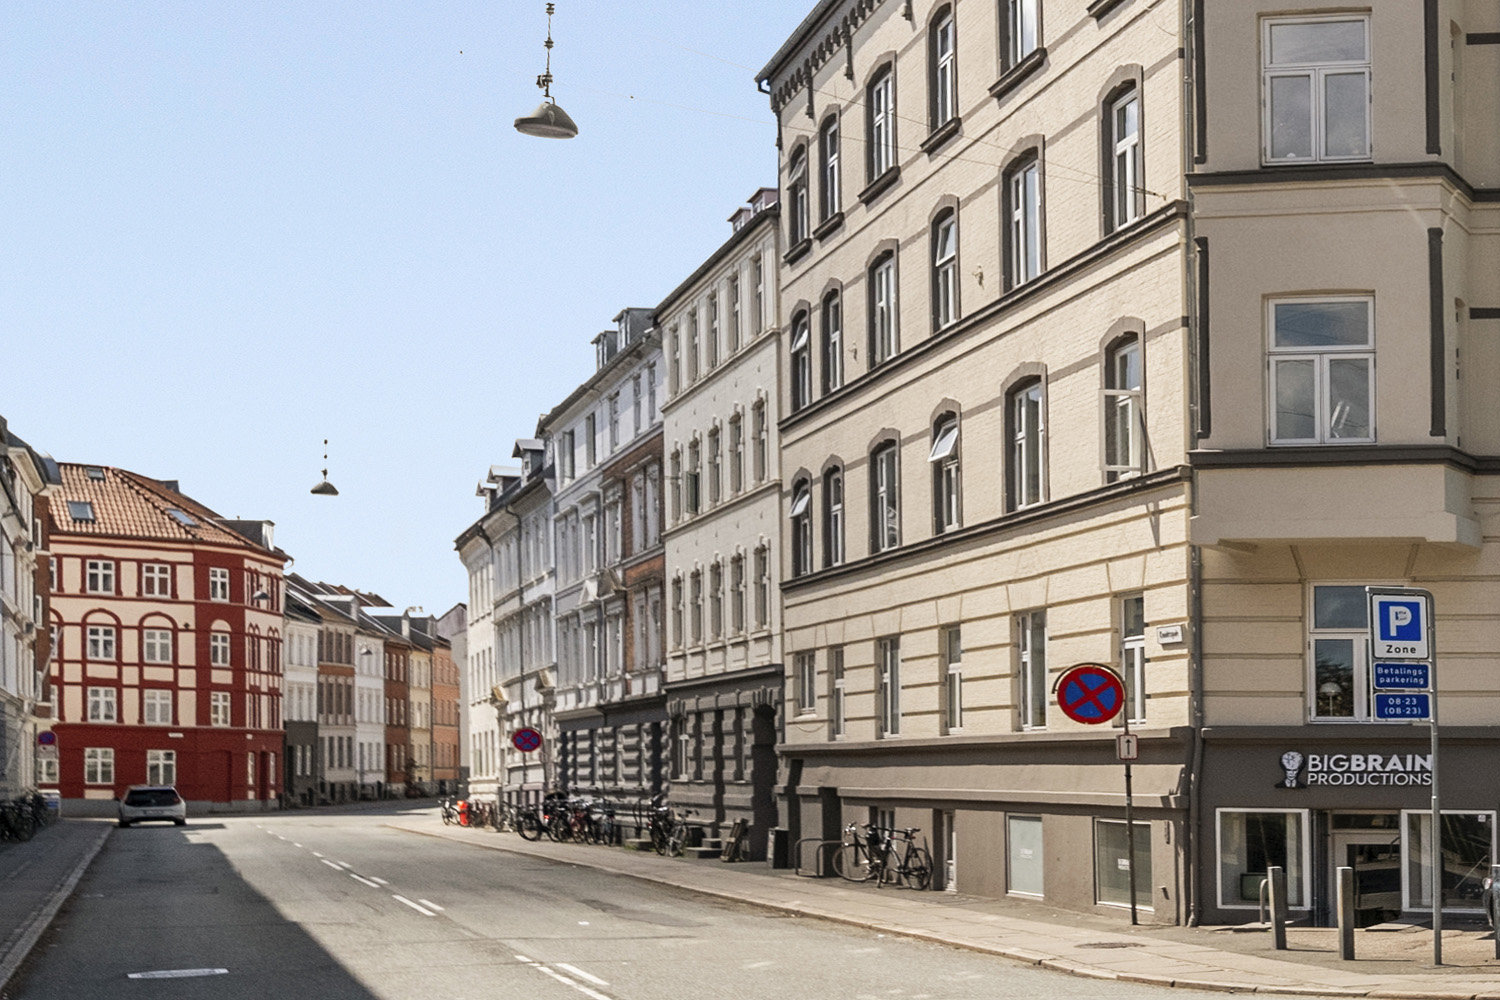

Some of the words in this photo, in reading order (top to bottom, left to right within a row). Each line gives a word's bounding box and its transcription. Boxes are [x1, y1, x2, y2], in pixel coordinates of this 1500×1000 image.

[1389, 606, 1412, 637] P
[1386, 644, 1417, 654] Zone
[1377, 667, 1426, 676] Betalings-
[1379, 677, 1424, 685] parkering
[1388, 697, 1417, 705] 08-23
[1384, 706, 1421, 715] (08-23)
[1307, 773, 1432, 785] PRODUCTIONS
